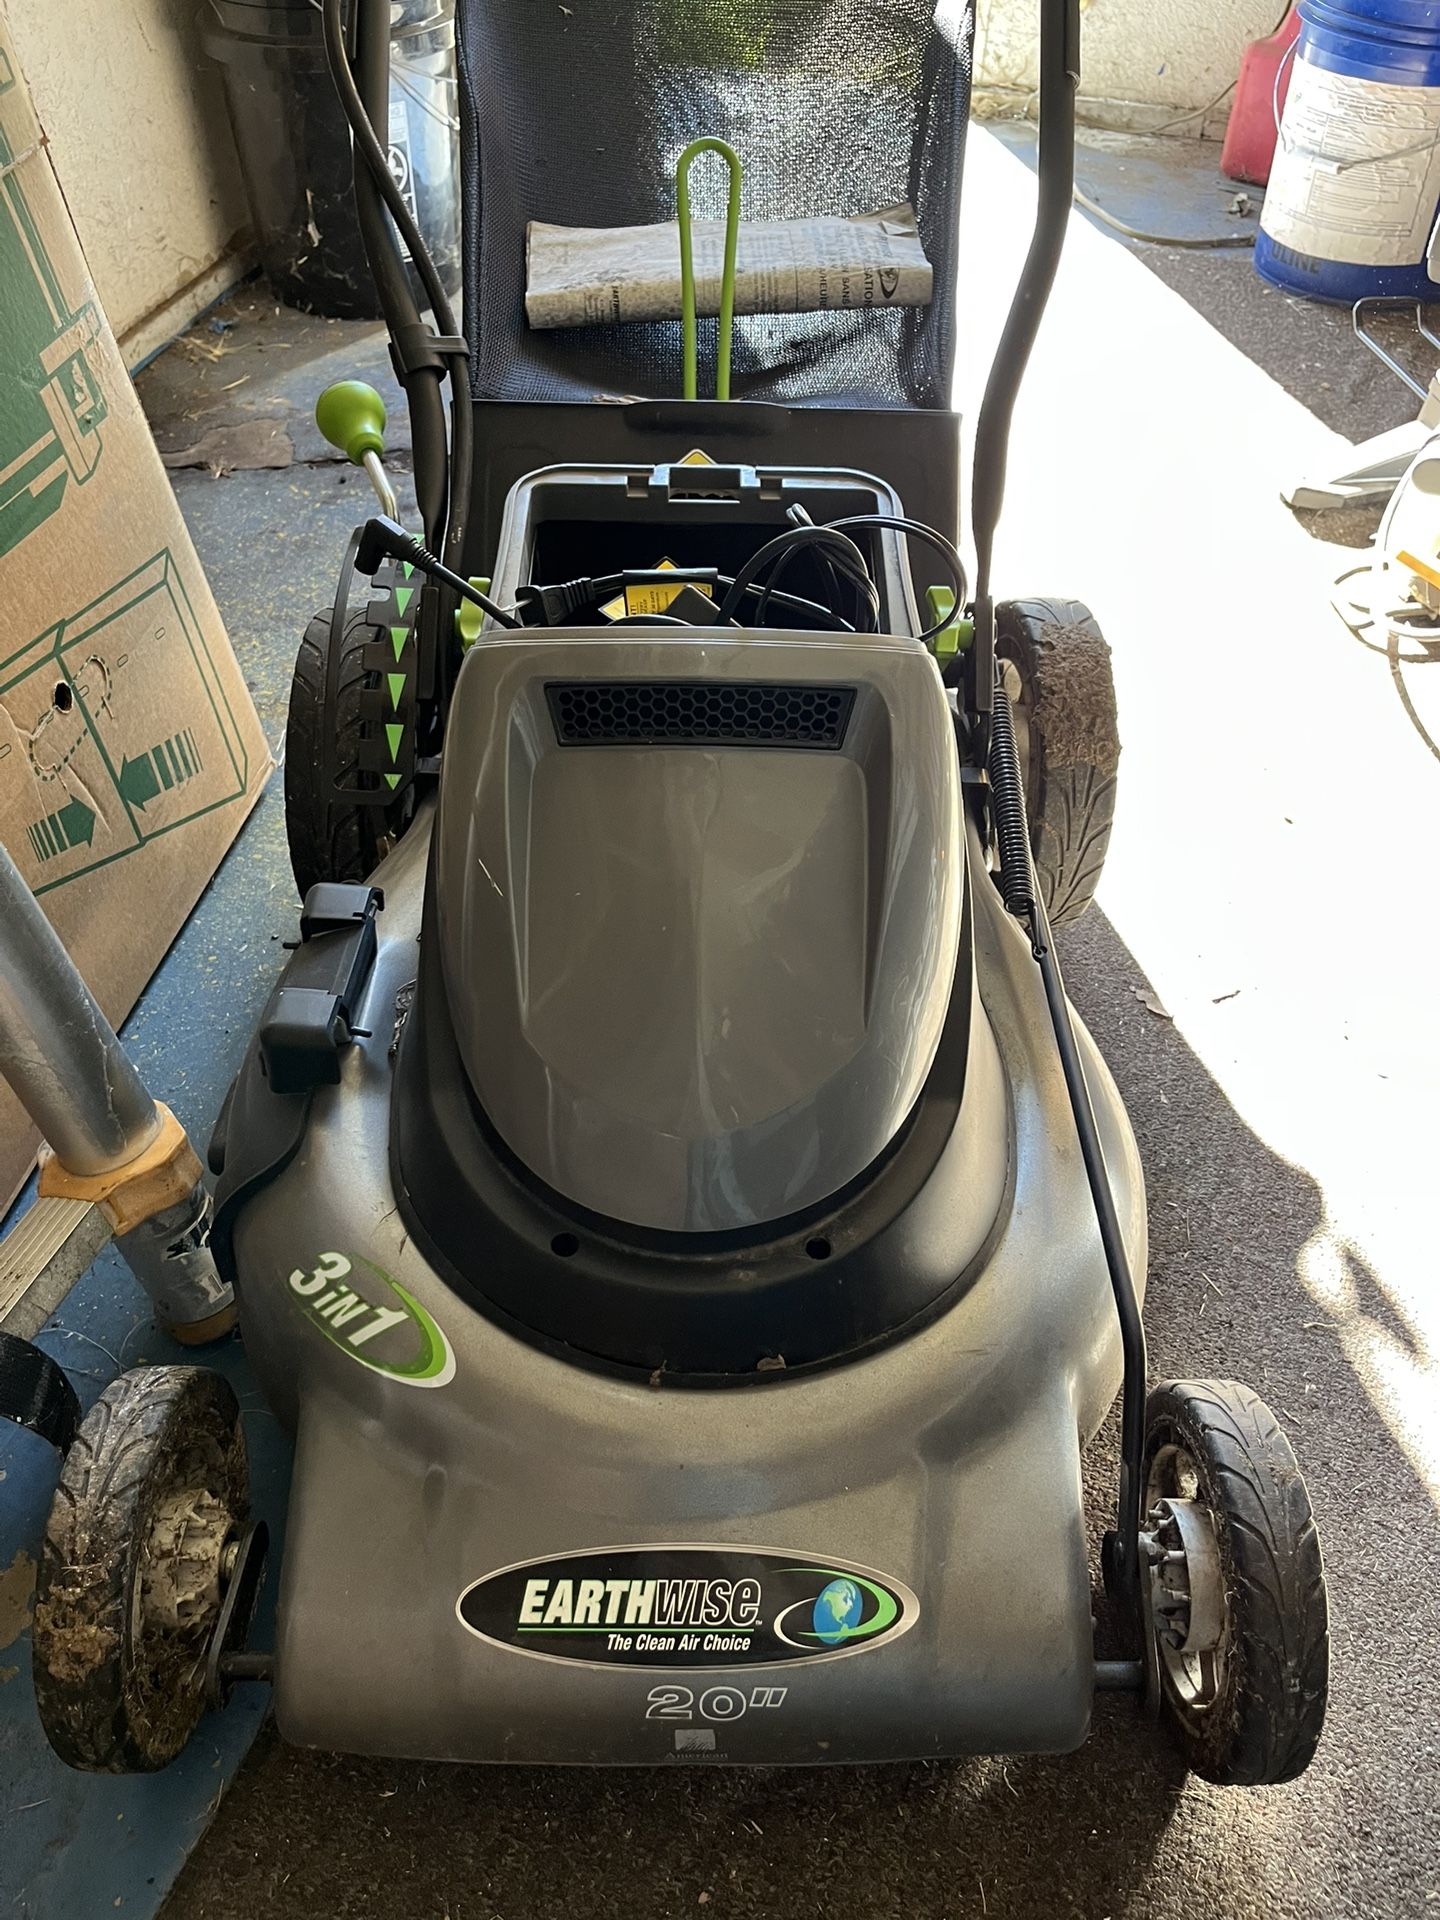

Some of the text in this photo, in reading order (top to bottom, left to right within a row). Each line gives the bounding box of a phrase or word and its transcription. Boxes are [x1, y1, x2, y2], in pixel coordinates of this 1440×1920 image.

[1272, 242, 1320, 274] ULINE
[289, 1252, 352, 1295] 3
[347, 1306, 409, 1347] 1
[607, 1633, 751, 1651] The Clean Air Choice
